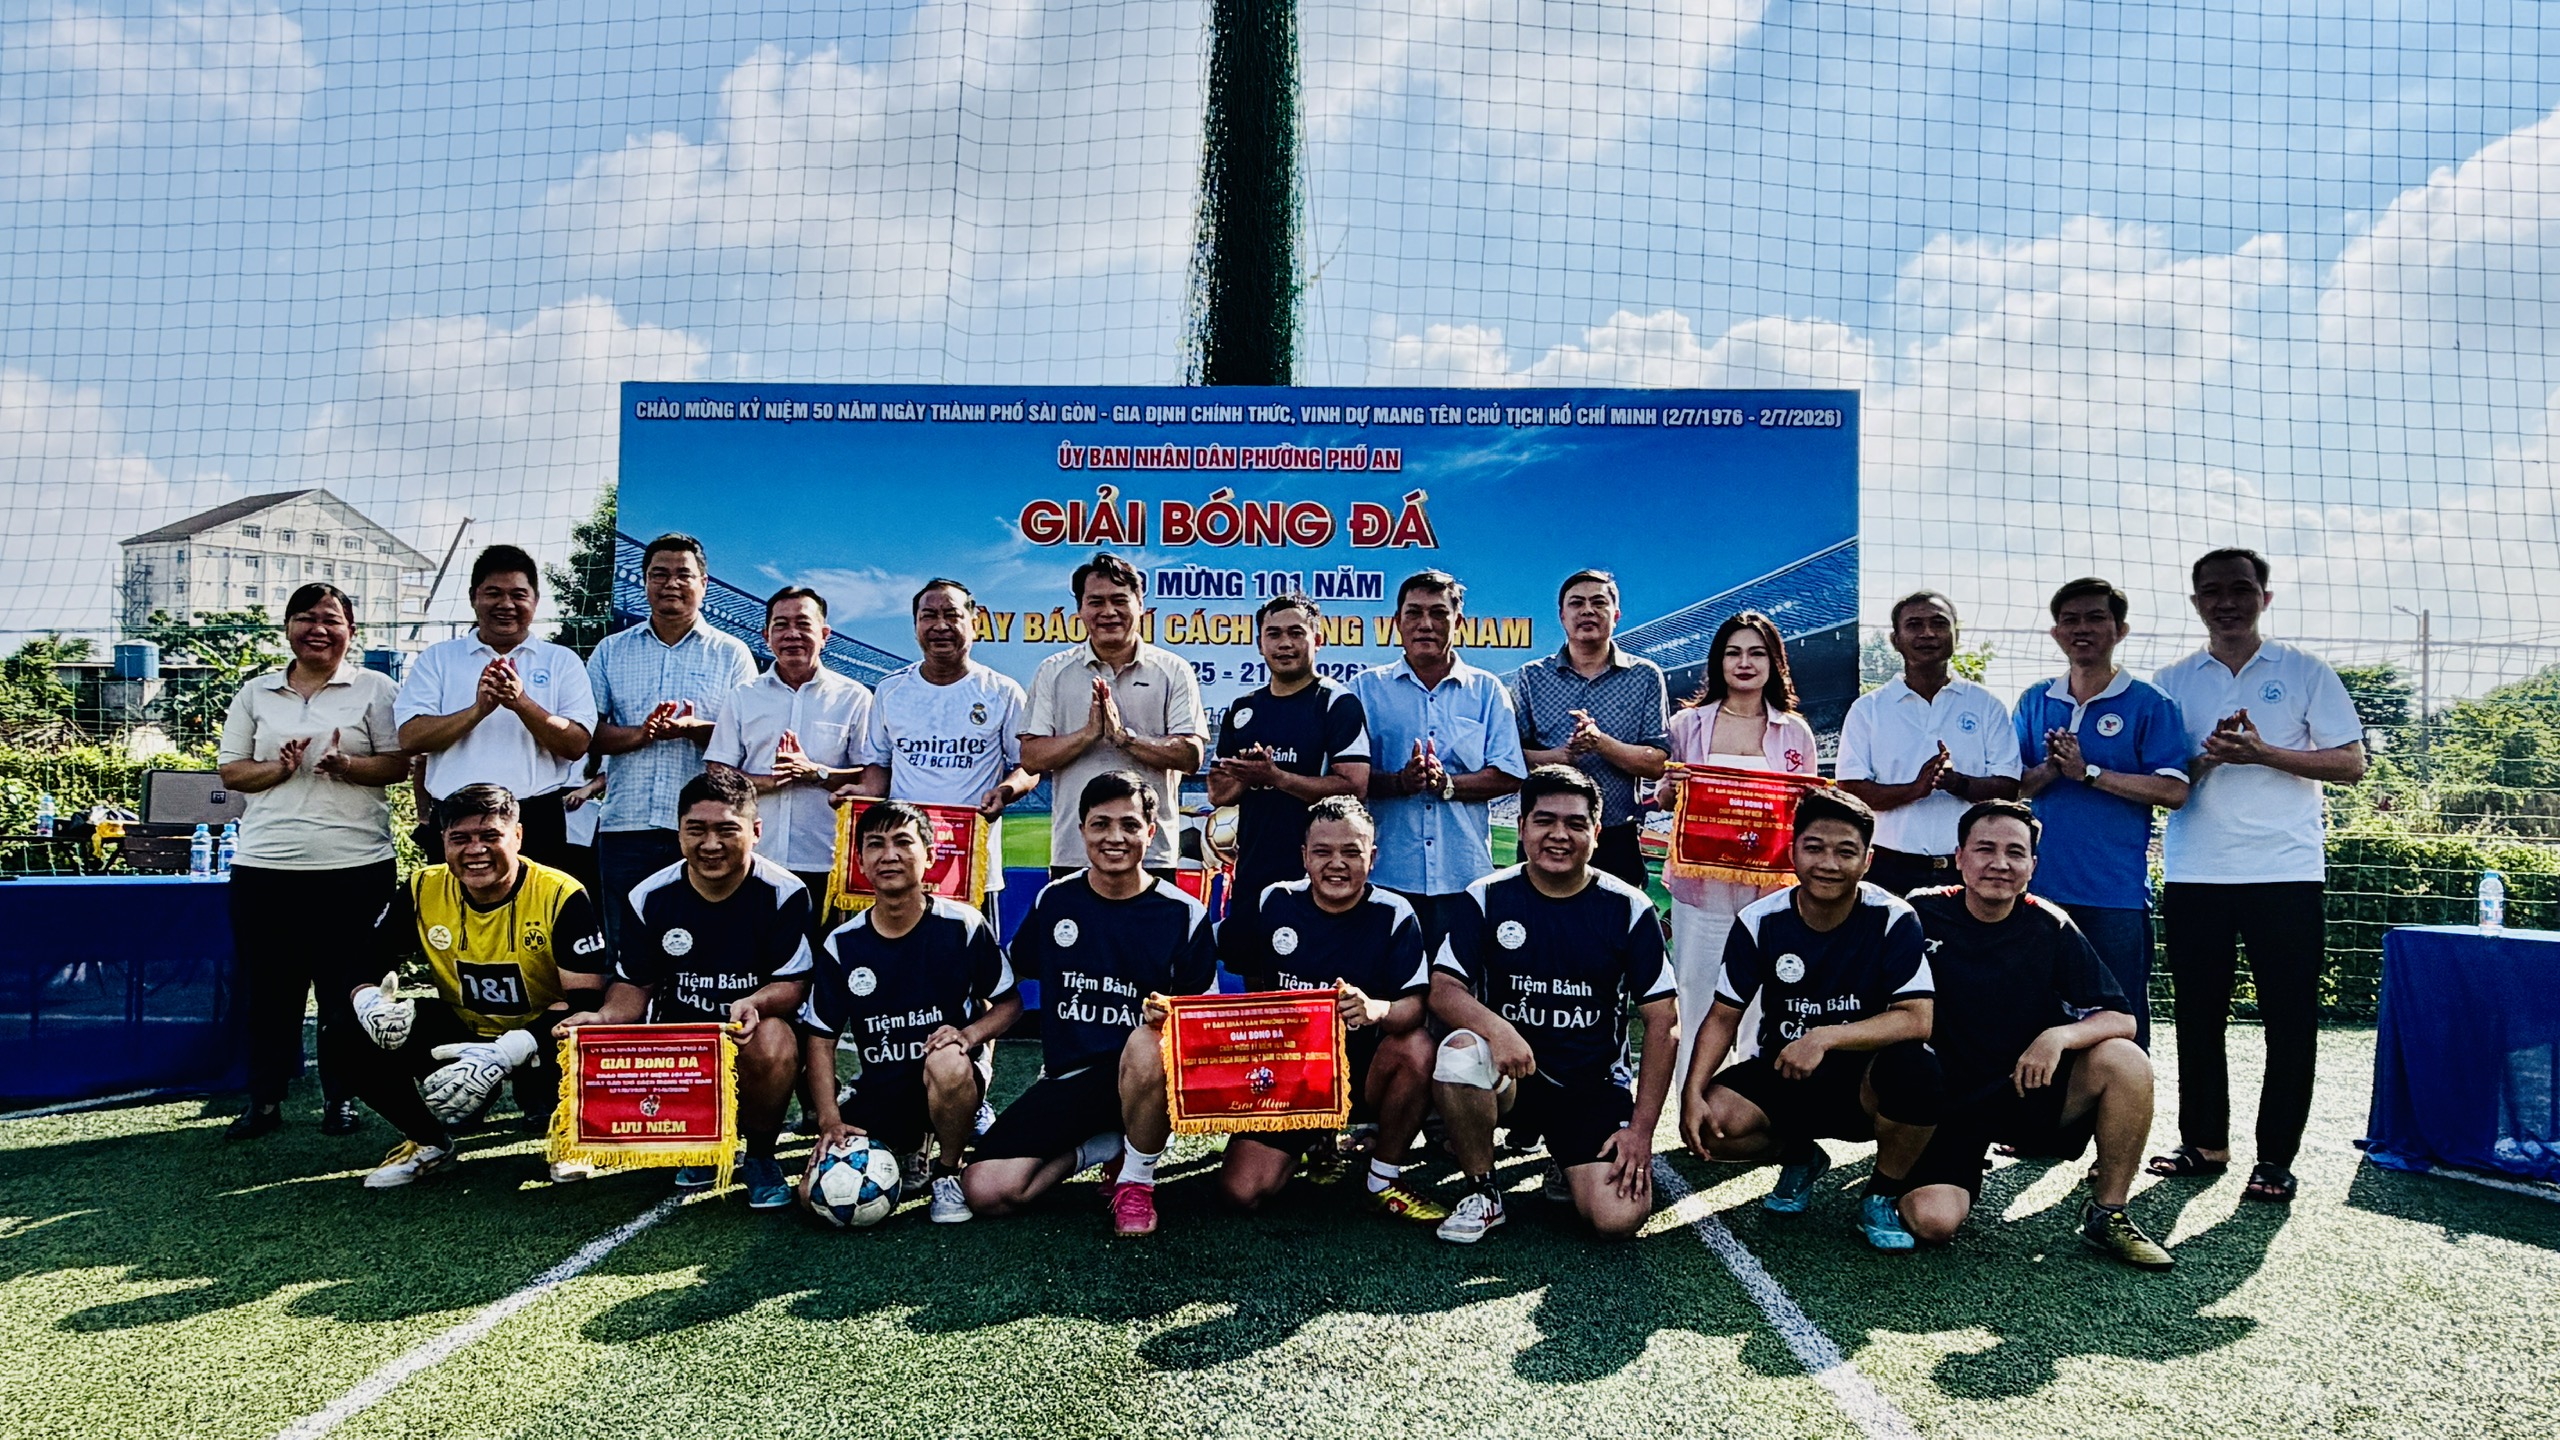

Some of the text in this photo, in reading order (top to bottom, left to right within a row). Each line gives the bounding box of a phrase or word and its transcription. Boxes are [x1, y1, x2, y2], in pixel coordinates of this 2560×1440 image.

[635, 398, 680, 418] CHÀO
[684, 398, 735, 418] MỪNG
[738, 396, 760, 418] KỶ
[765, 399, 808, 422] NIỆM
[812, 401, 834, 419] 50
[837, 400, 877, 419] NĂM
[881, 400, 925, 420] NGÀY
[930, 401, 985, 421] THÀNH
[989, 399, 1025, 421] PHỐ
[1028, 401, 1057, 421] SÀI
[1061, 401, 1096, 422] GÒN
[1112, 405, 1141, 422] GIA
[1145, 405, 1186, 425] ĐỊNH
[1191, 403, 1243, 423] CHÍNH
[1248, 403, 1296, 425] THỨC,
[1301, 406, 1341, 423] VINH
[1345, 405, 1371, 427] DỰ
[1373, 407, 1424, 424] MANG
[1429, 404, 1462, 424] TÊN
[1466, 402, 1500, 424] CHỦ
[1505, 407, 1543, 428] TỊCH
[1577, 404, 1606, 424] CHÍ
[1610, 408, 1657, 425] MINH
[1662, 408, 1743, 428] (2/7/1976
[1760, 409, 1842, 428] 2/7/2026)
[1058, 440, 1401, 470] ỦY BAN NHÂN DÂN PHƯỜNG PHÚ AN
[1020, 484, 1439, 549] GIẢI BÓNG ĐÁ
[1156, 563, 1246, 600] MỪNG
[1252, 571, 1301, 600] 101
[1313, 565, 1384, 600] NĂM
[1164, 608, 1252, 645] CÁCH
[1319, 614, 1363, 646] NG
[1453, 617, 1532, 648] NAM
[896, 734, 987, 754] Emirates
[930, 754, 974, 769] BETTER
[524, 931, 545, 946] BVB
[463, 974, 520, 1003] 1&1
[676, 971, 759, 993] Tiệm Bánh
[1062, 970, 1138, 998] Tiệm Bánh
[1509, 974, 1593, 997] Tiệm Bánh
[864, 1005, 943, 1036] Tiệm Bánh
[1057, 993, 1097, 1023] GẤU
[1501, 996, 1601, 1029] GẤU DÂU
[1785, 997, 1822, 1019] Tiệm
[863, 1035, 905, 1064] GẤU
[646, 1118, 687, 1136] NIỆM
